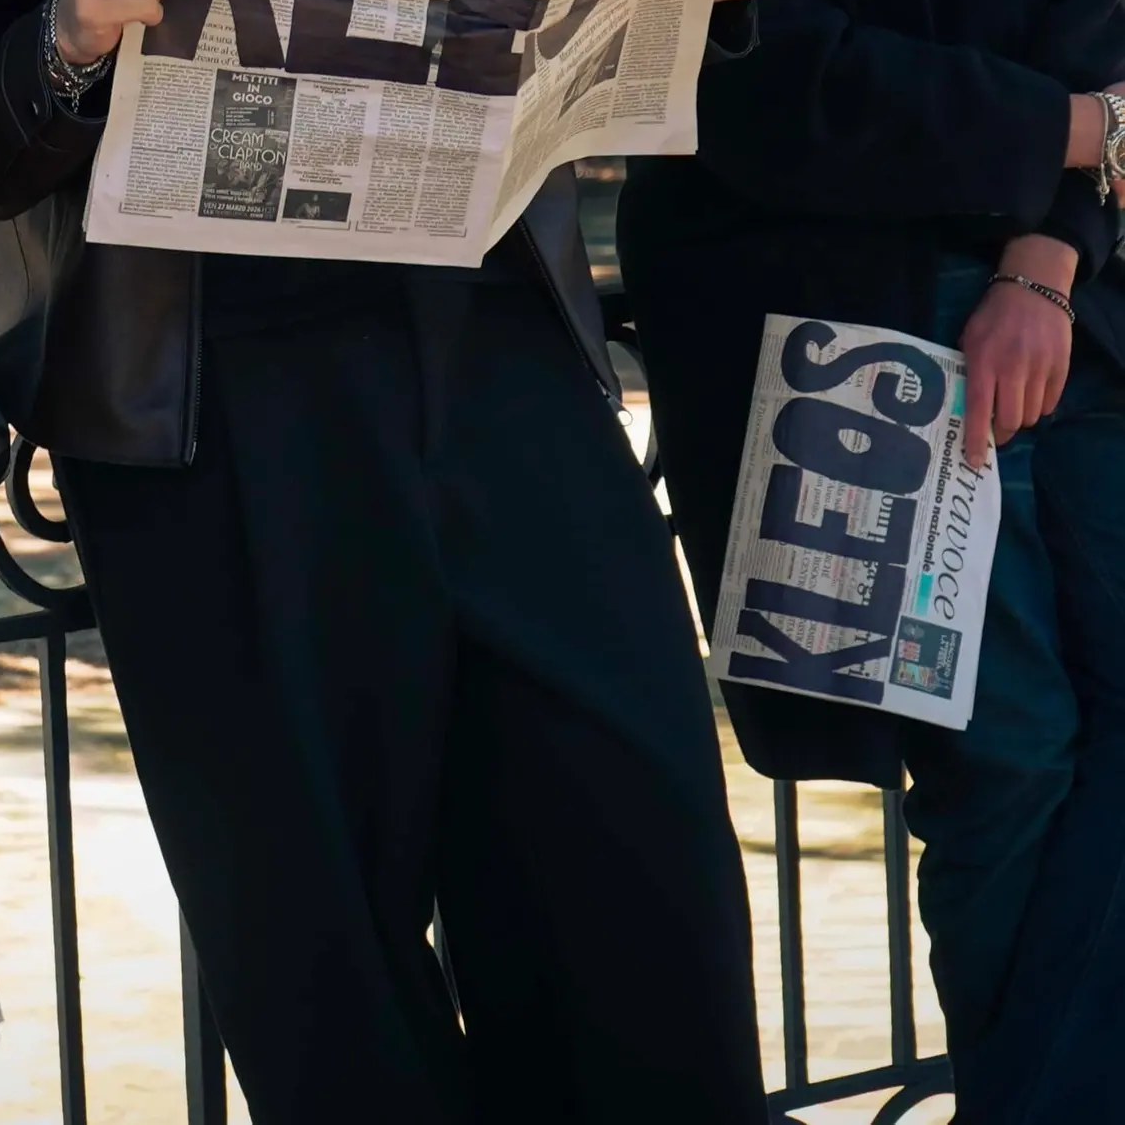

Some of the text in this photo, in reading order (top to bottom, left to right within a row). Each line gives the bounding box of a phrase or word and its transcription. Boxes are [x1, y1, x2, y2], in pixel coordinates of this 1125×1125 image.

[232, 73, 279, 86] METTITI
[247, 83, 261, 93] IN
[232, 92, 273, 105] GIOCO
[211, 127, 265, 146] CREAM
[218, 143, 287, 166] CLAPTON
[932, 428, 959, 505] Quotidiano
[728, 320, 946, 706] KLEOS
[920, 505, 945, 574] nazionale
[928, 450, 994, 623] travoce
